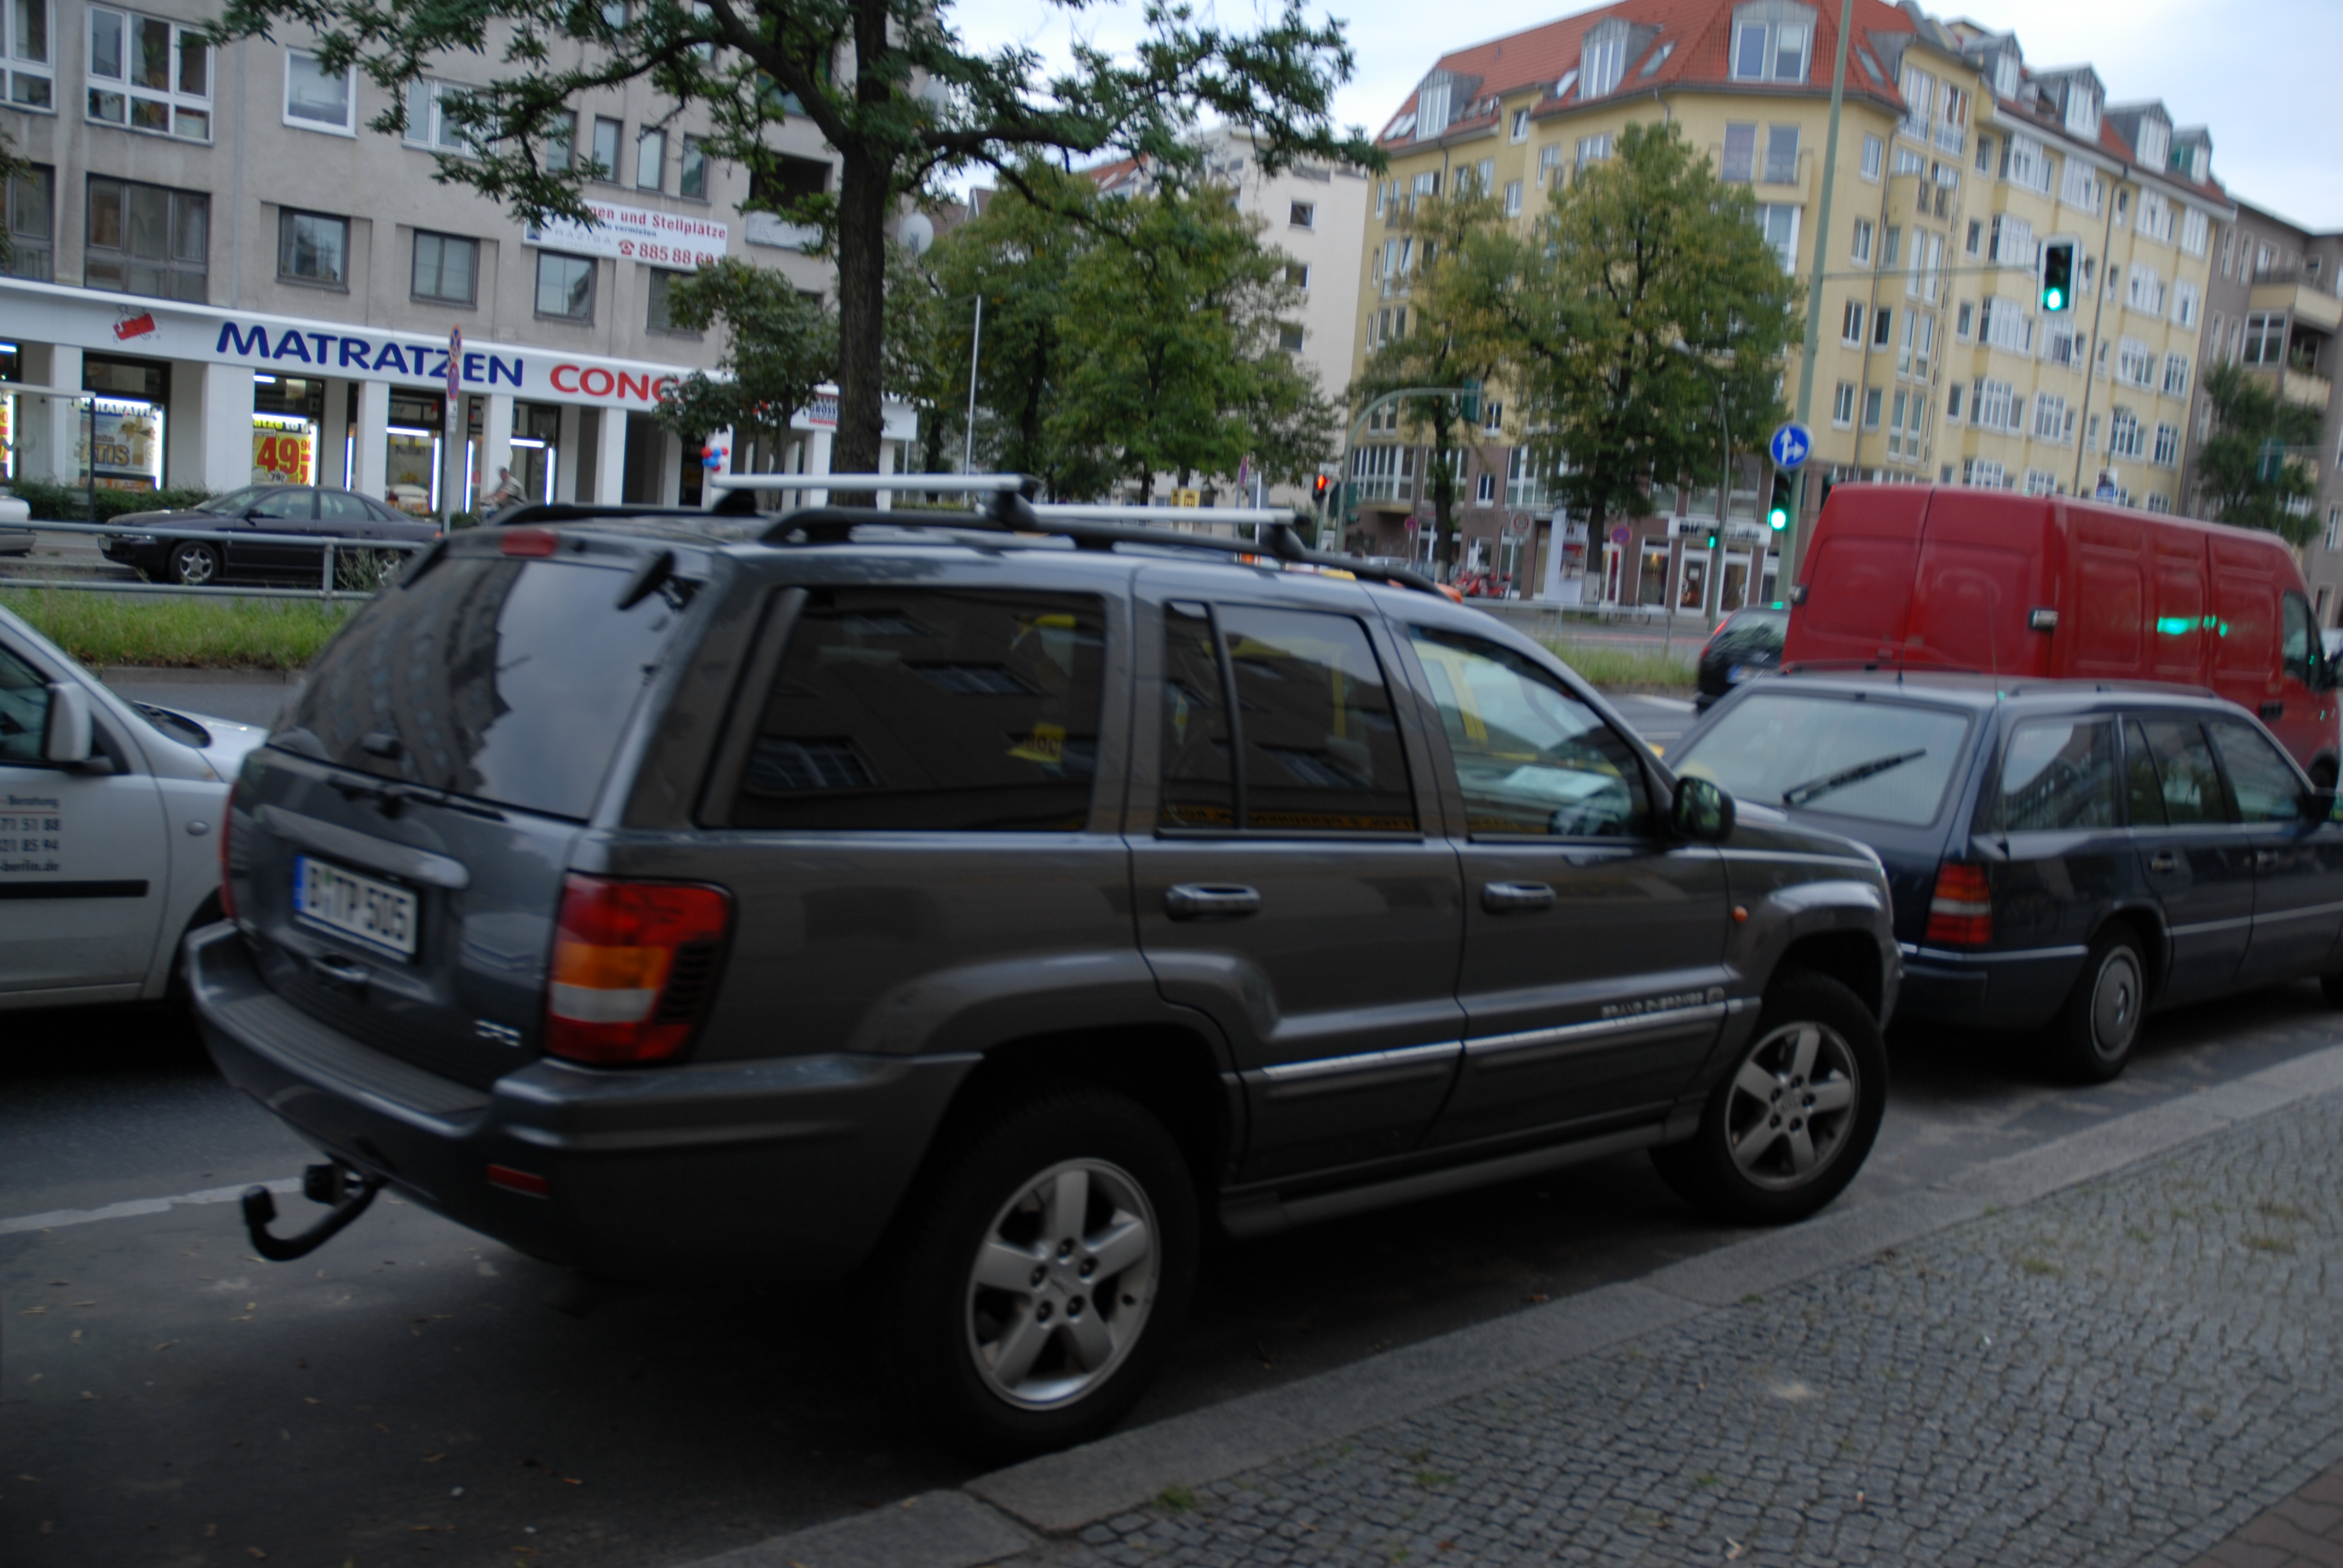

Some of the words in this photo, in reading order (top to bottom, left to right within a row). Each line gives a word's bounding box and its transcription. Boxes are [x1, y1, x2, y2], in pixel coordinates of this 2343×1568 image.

[614, 223, 657, 238] vermieten
[621, 211, 646, 226] und
[652, 215, 726, 240] Stellplätze
[639, 243, 668, 261] 885
[672, 248, 691, 265] 88
[215, 321, 523, 387] MATRATZEN
